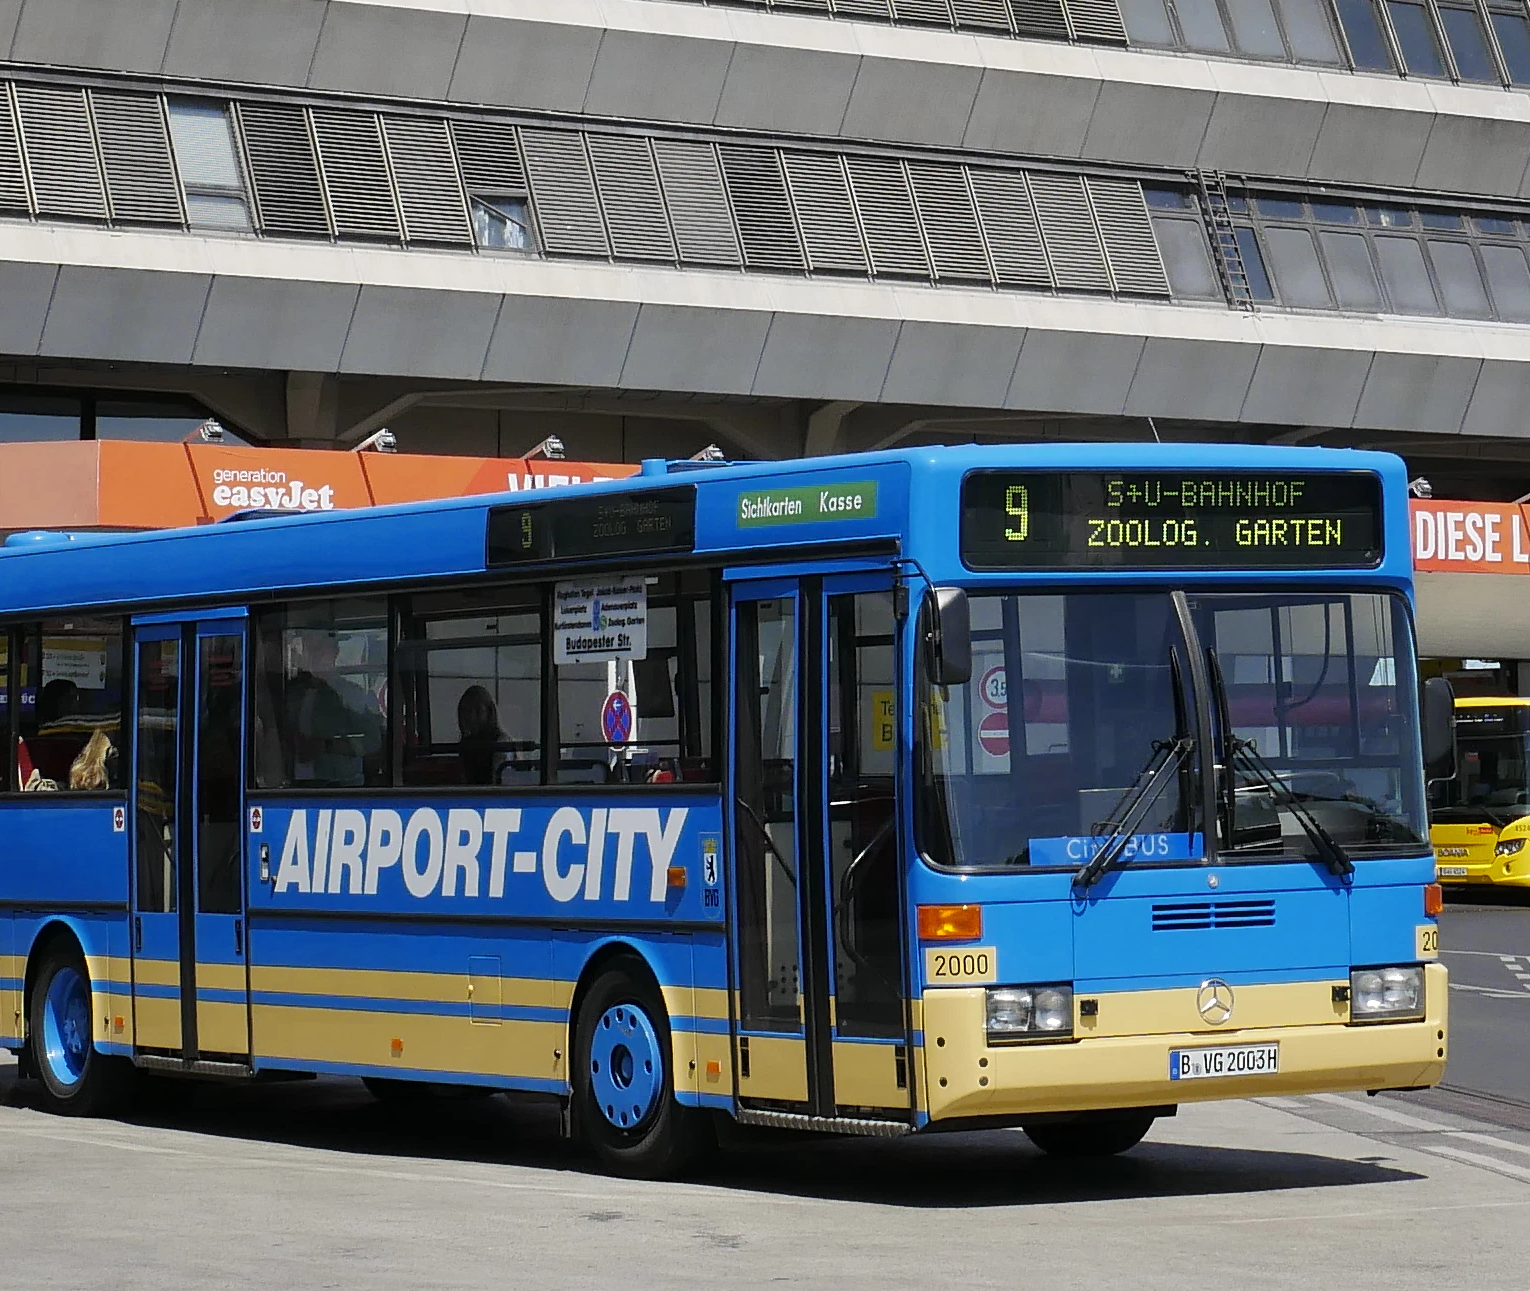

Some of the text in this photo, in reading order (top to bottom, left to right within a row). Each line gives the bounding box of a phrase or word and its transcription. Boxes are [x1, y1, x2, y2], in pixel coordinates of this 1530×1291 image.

[213, 468, 286, 483] generation
[213, 481, 334, 509] easyJet
[819, 491, 862, 512] Kasse
[1107, 480, 1306, 507] S+U-BAHNHOF
[1005, 485, 1029, 542] 9
[1088, 518, 1342, 546] ZOOLOG. GARTEN
[1415, 511, 1502, 562] DIESE
[566, 633, 632, 650] Budapester Str.
[273, 806, 689, 902] AIRPORT-CITY
[1124, 834, 1169, 857] BUS
[1422, 931, 1438, 952] 20
[934, 954, 989, 978] 2000
[1181, 1054, 1191, 1075] B
[1204, 1052, 1223, 1074] VG
